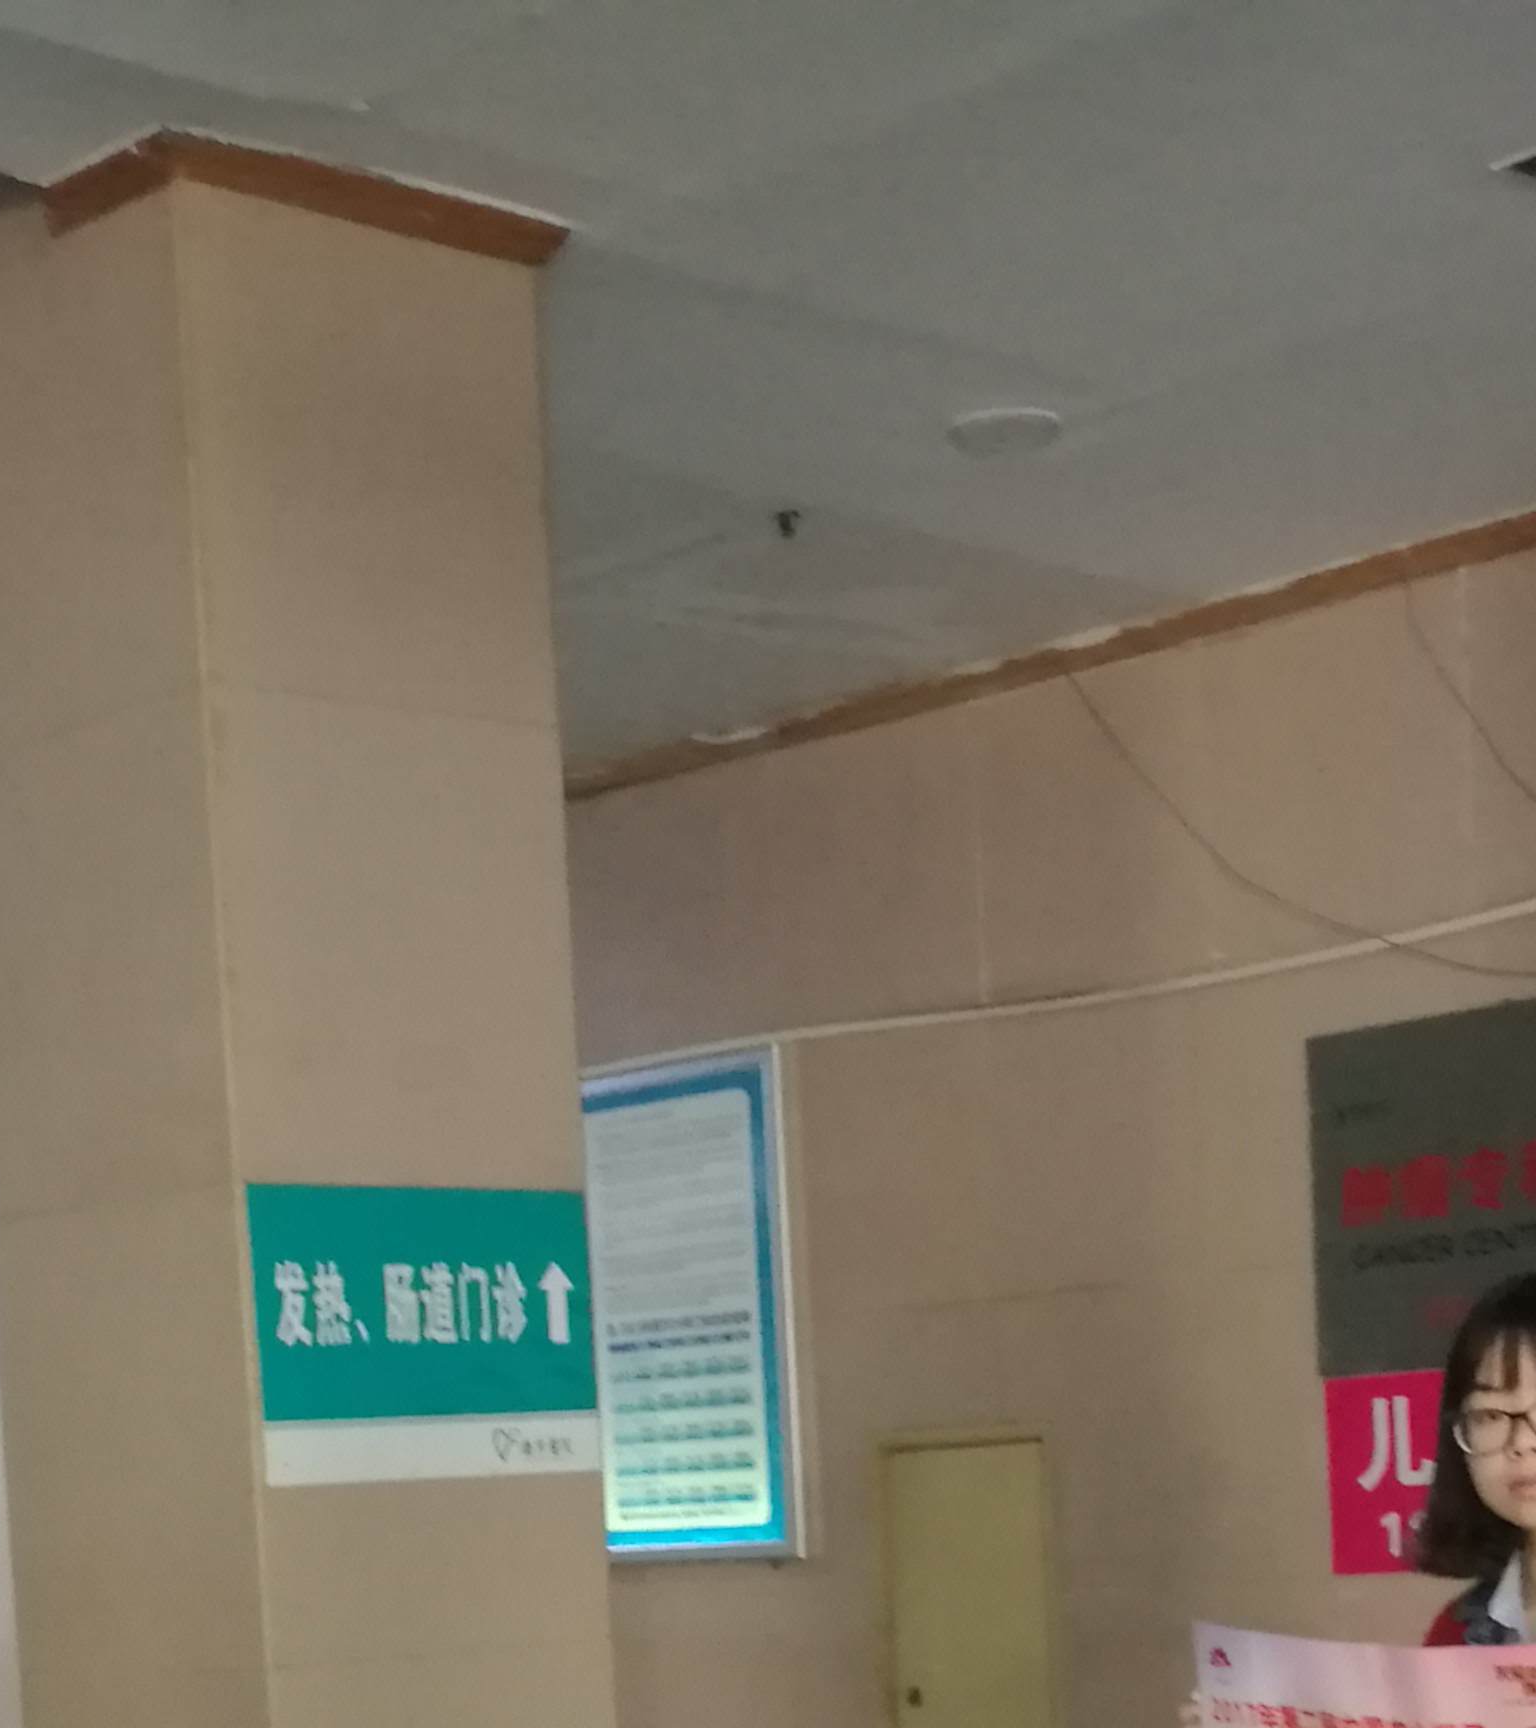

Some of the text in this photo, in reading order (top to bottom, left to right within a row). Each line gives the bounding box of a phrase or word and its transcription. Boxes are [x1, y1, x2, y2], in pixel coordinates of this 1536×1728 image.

[274, 1260, 527, 1347] 发热、肠道门诊
